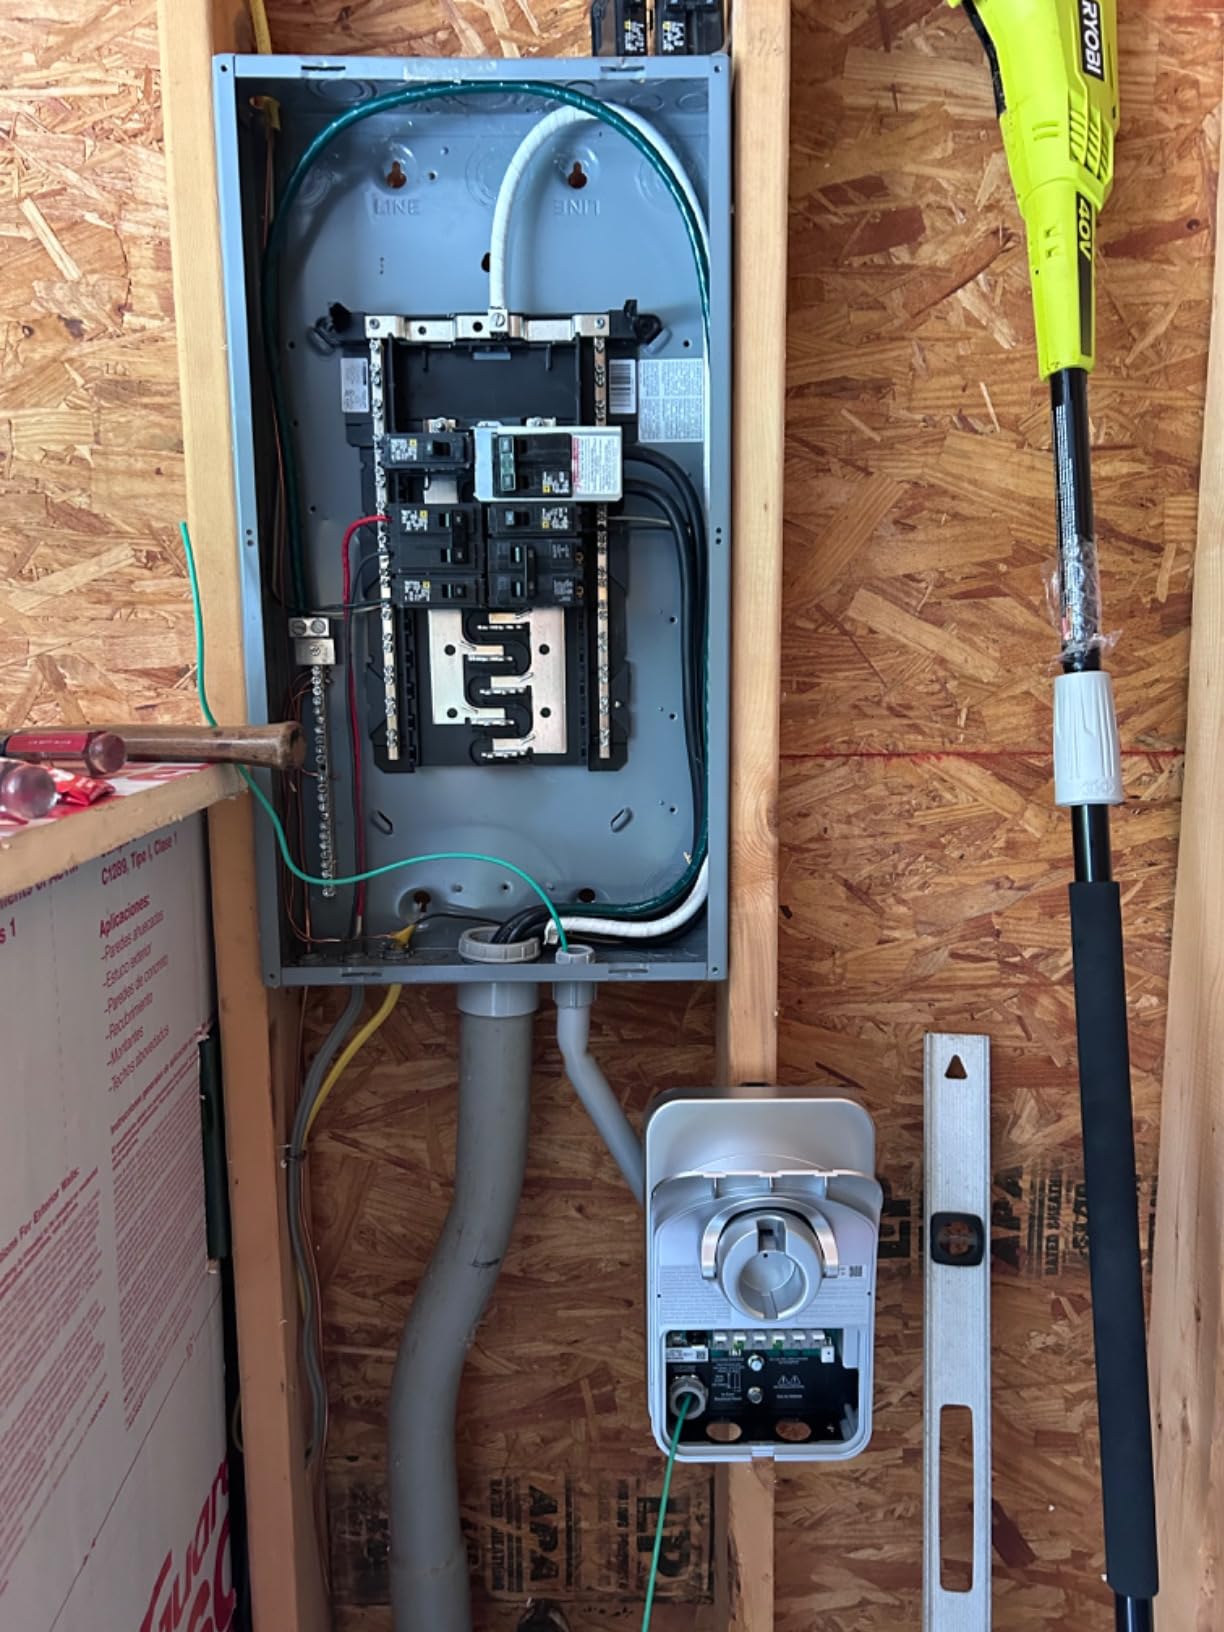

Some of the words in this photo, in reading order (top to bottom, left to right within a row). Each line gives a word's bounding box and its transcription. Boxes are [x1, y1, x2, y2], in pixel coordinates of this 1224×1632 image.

[1082, 0, 1101, 75] RYOBI
[374, 199, 421, 216] LINE
[1078, 199, 1090, 260] 40V
[529, 1484, 559, 1582] APA
